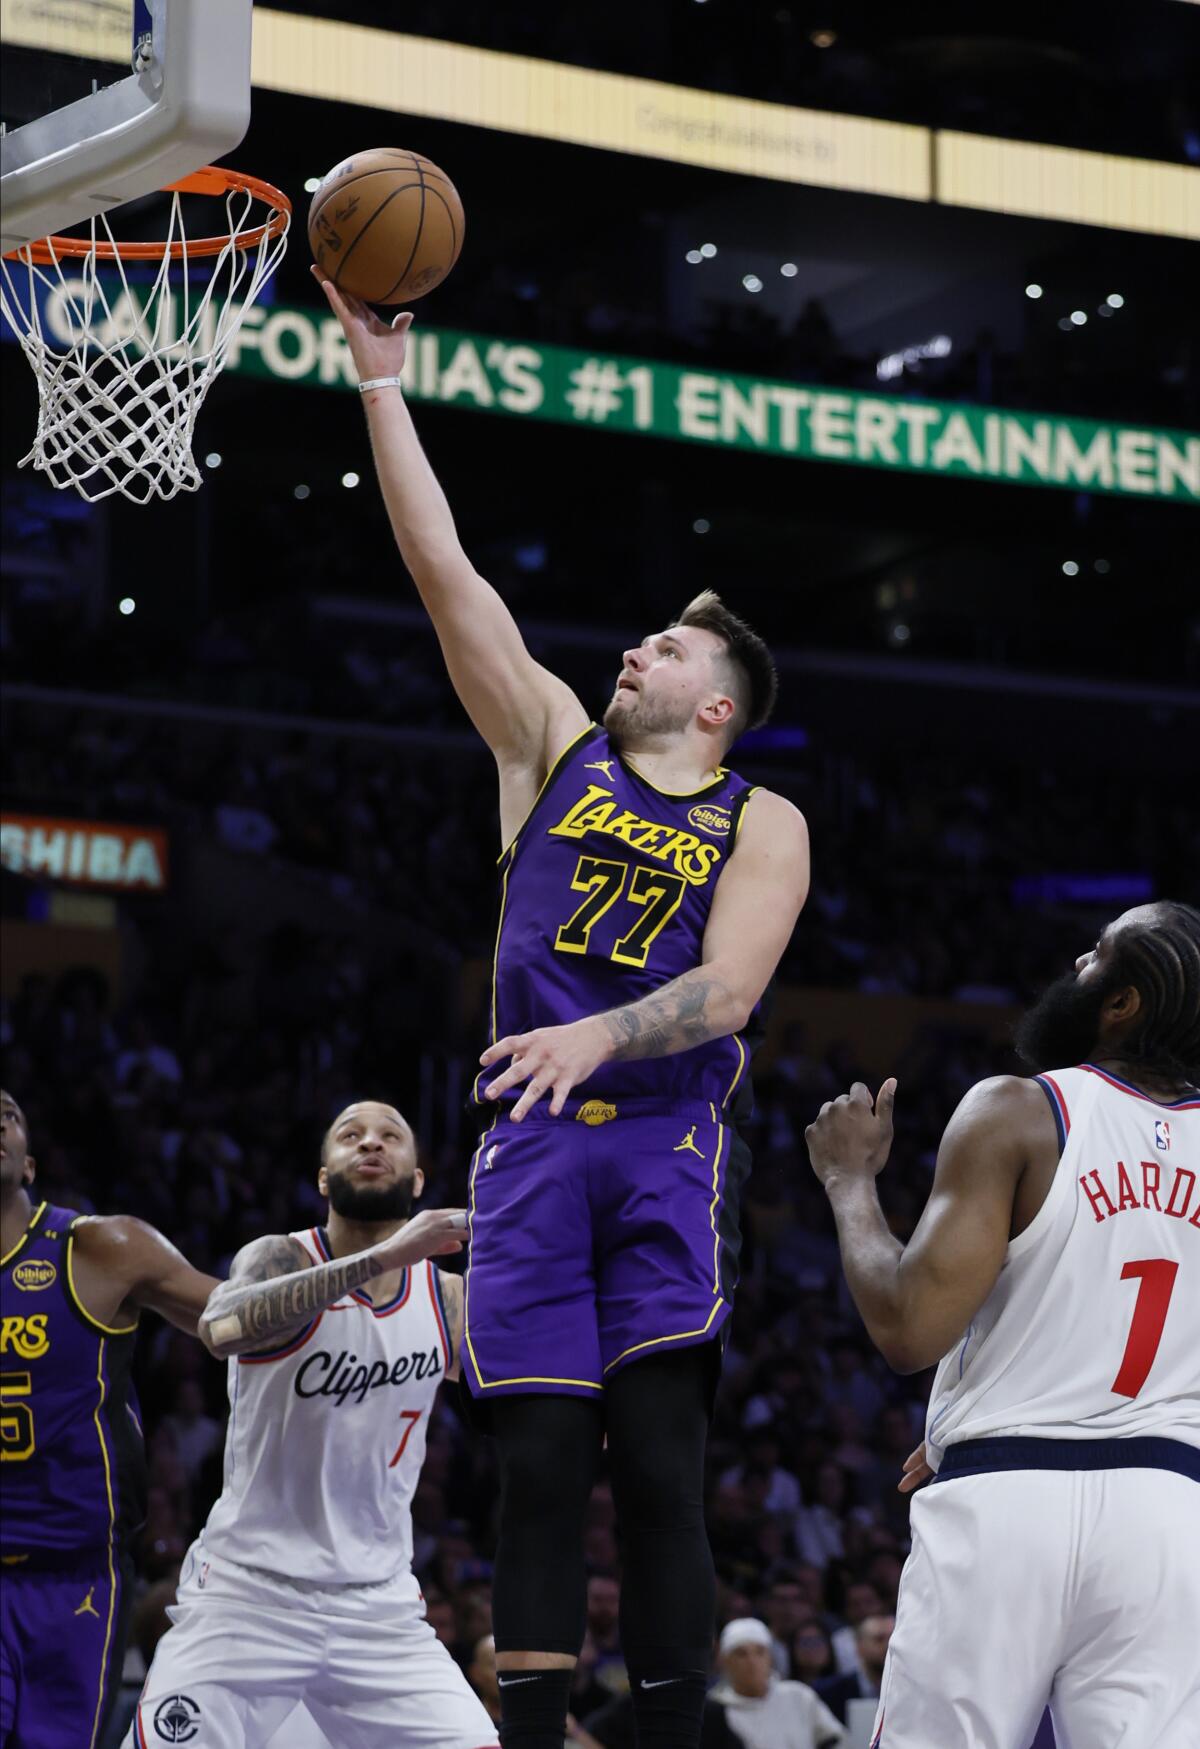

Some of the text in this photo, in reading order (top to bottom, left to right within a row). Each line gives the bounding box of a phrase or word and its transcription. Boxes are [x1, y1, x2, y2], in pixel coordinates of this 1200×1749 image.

[566, 357, 655, 429] #1
[676, 372, 1200, 498] ENTERTAINMEN
[547, 784, 722, 886] LAKERS
[693, 808, 731, 830] bibigo
[554, 855, 688, 968] 77
[17, 1266, 54, 1282] bibigo
[1111, 1258, 1180, 1400] 1
[295, 1346, 442, 1408] Clippers
[388, 1410, 423, 1469] 7
